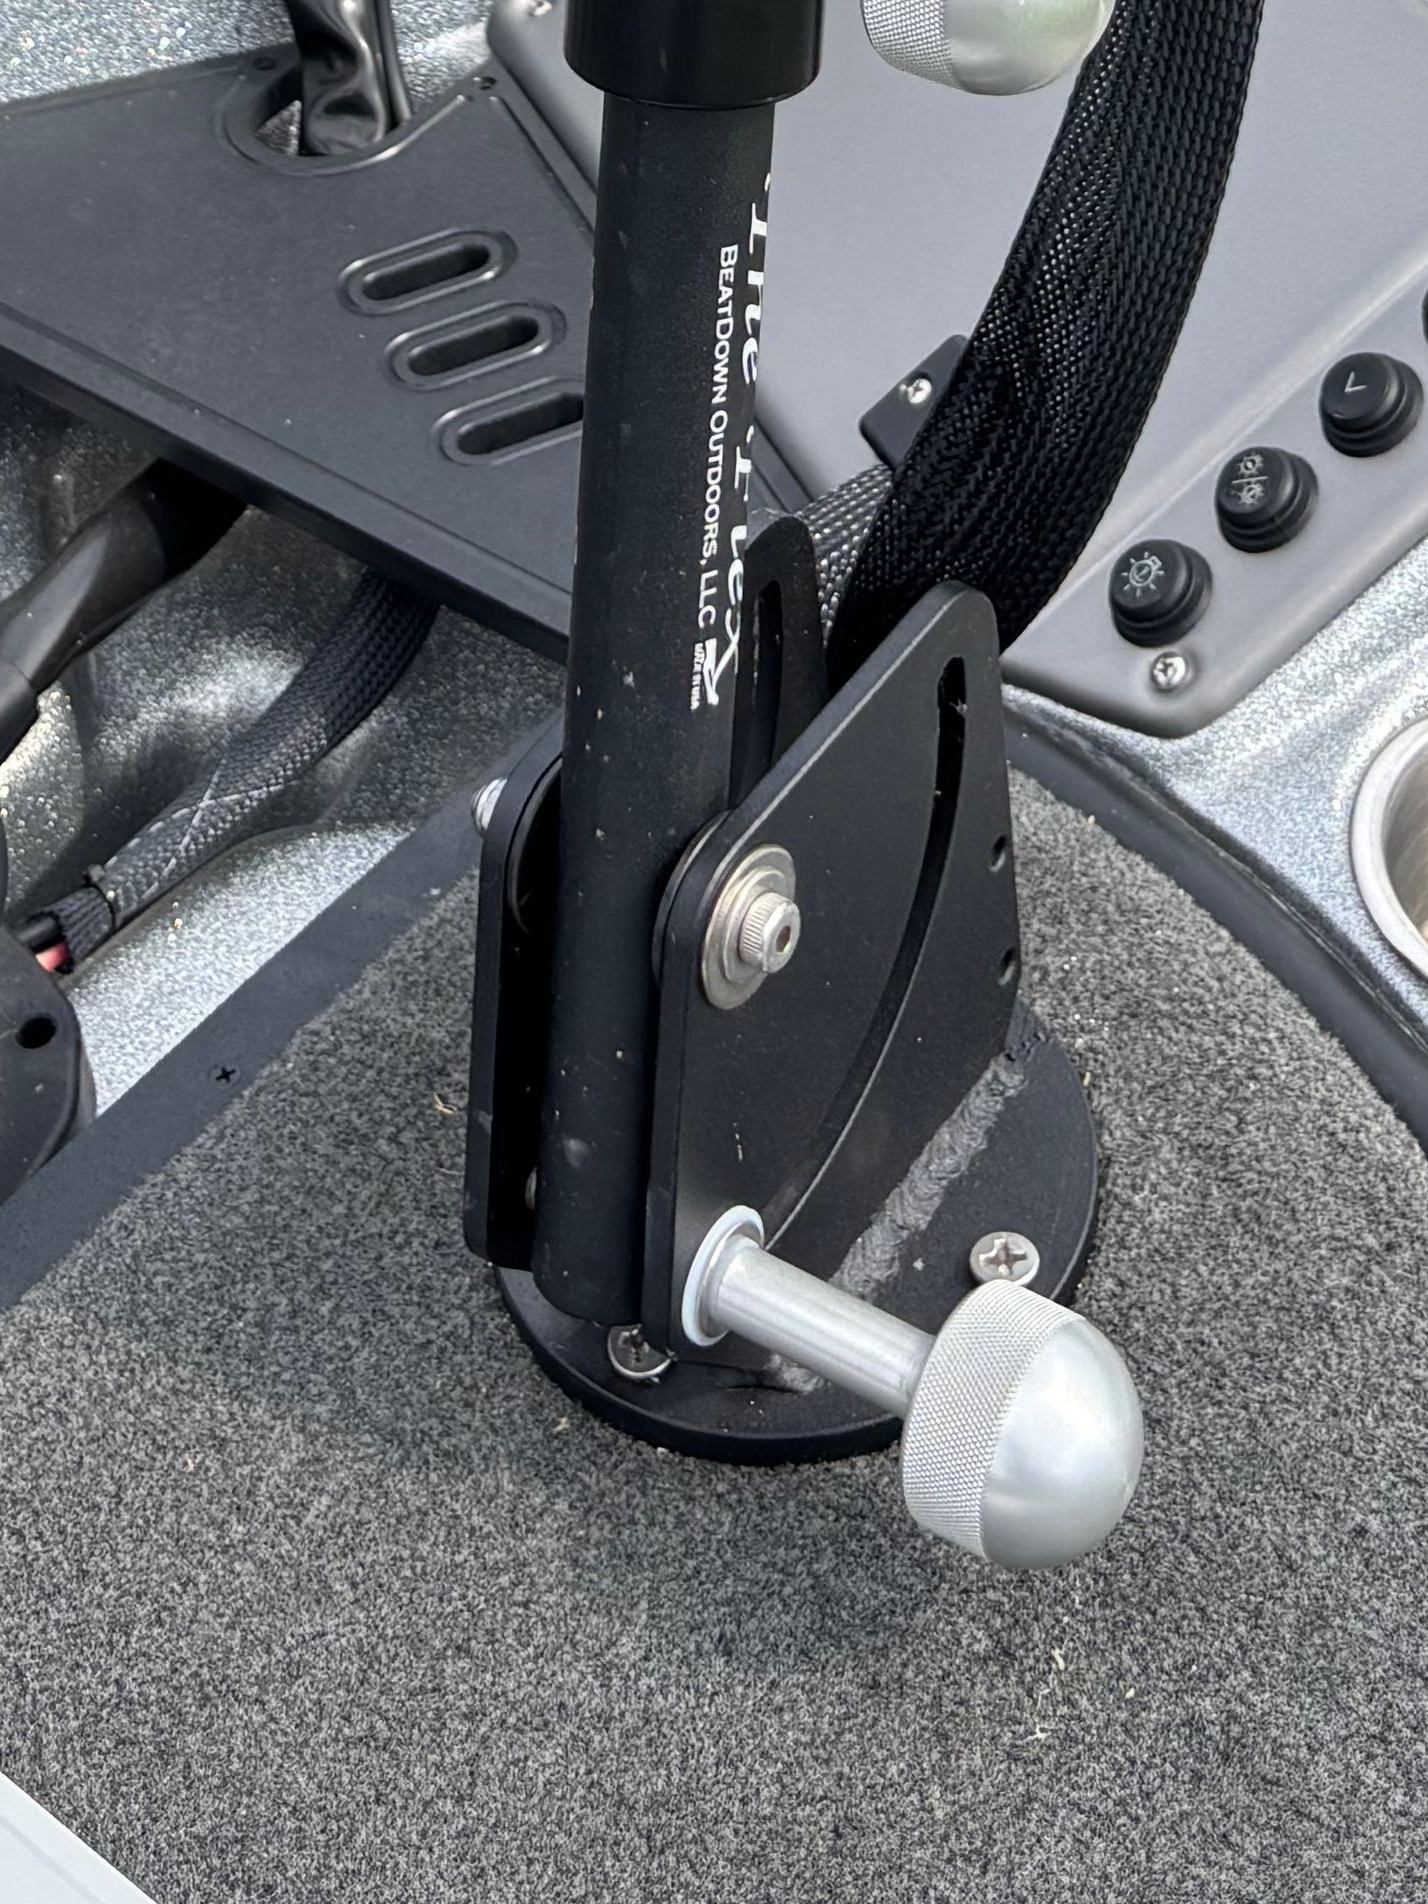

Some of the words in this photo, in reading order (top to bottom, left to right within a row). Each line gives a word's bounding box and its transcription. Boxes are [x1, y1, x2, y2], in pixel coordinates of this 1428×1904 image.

[710, 244, 740, 405] BEATDOWN
[699, 409, 729, 567] OUTDOORS,
[697, 569, 719, 629] LLC
